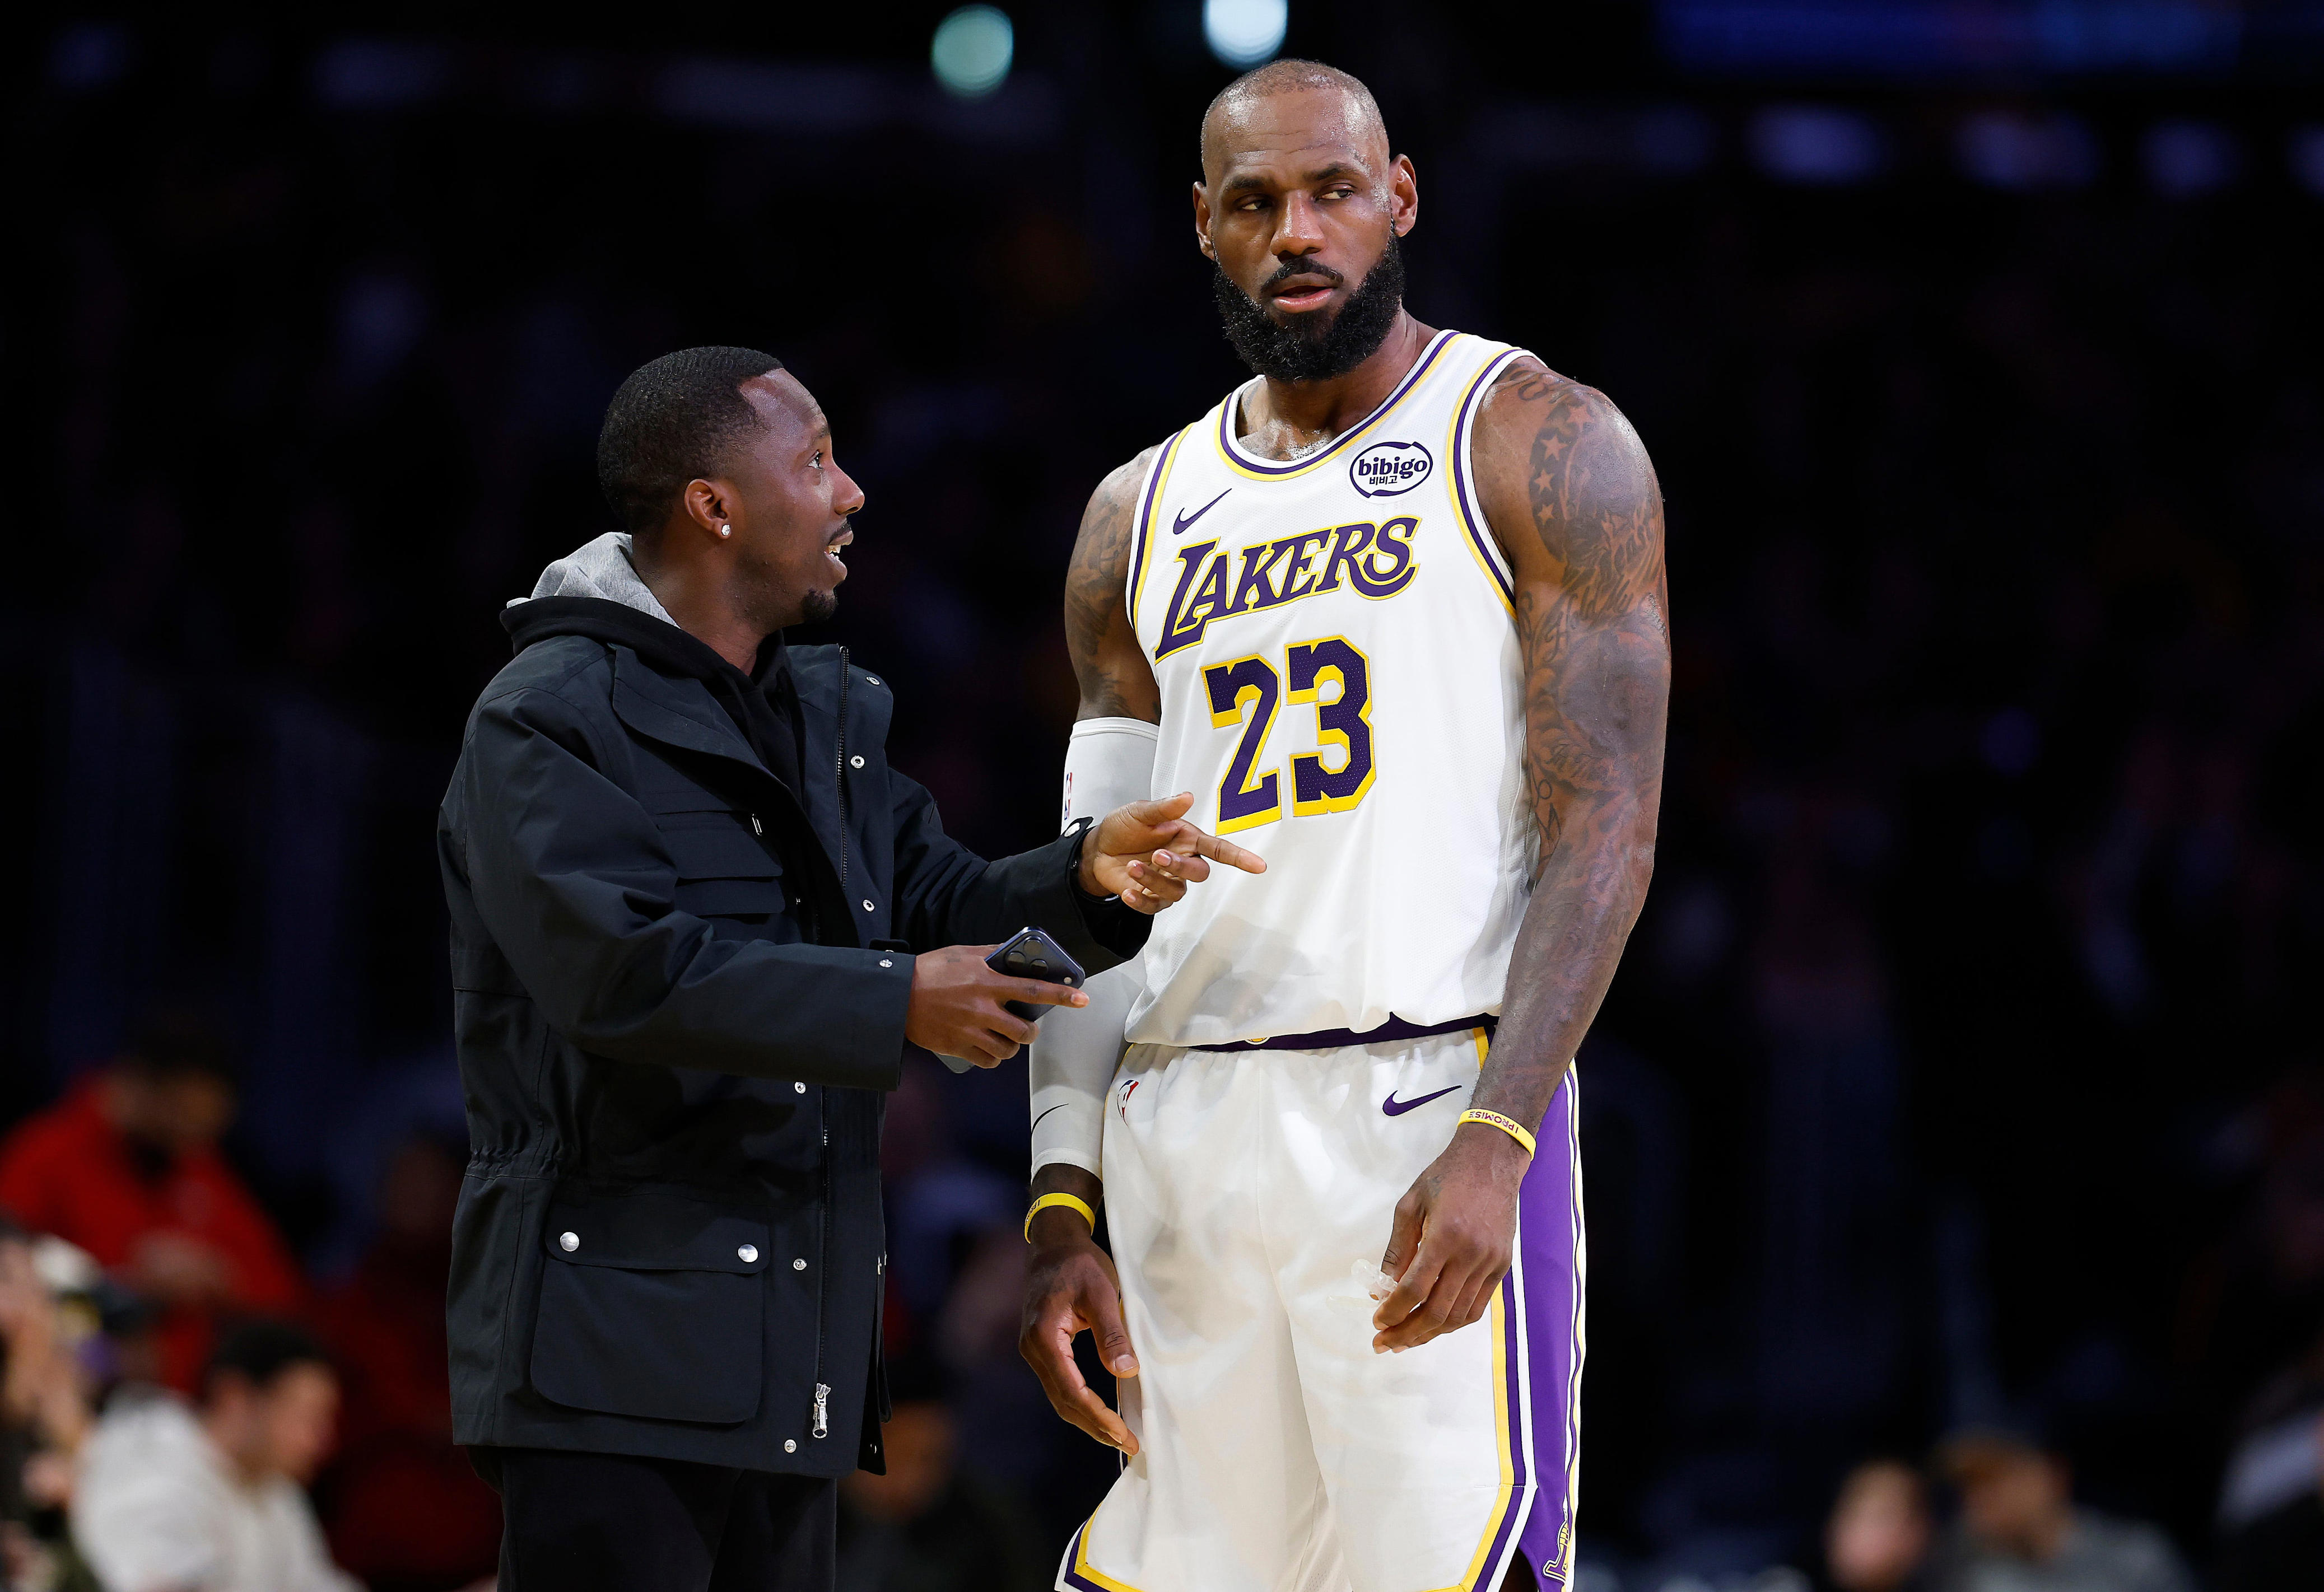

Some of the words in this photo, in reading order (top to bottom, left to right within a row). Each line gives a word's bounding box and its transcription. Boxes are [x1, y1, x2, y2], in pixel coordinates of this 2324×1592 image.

[1358, 456, 1427, 479] bibigo
[1370, 475, 1398, 485] 비비고
[1154, 515, 1422, 665] LAKERS
[1200, 635, 1377, 837] 23
